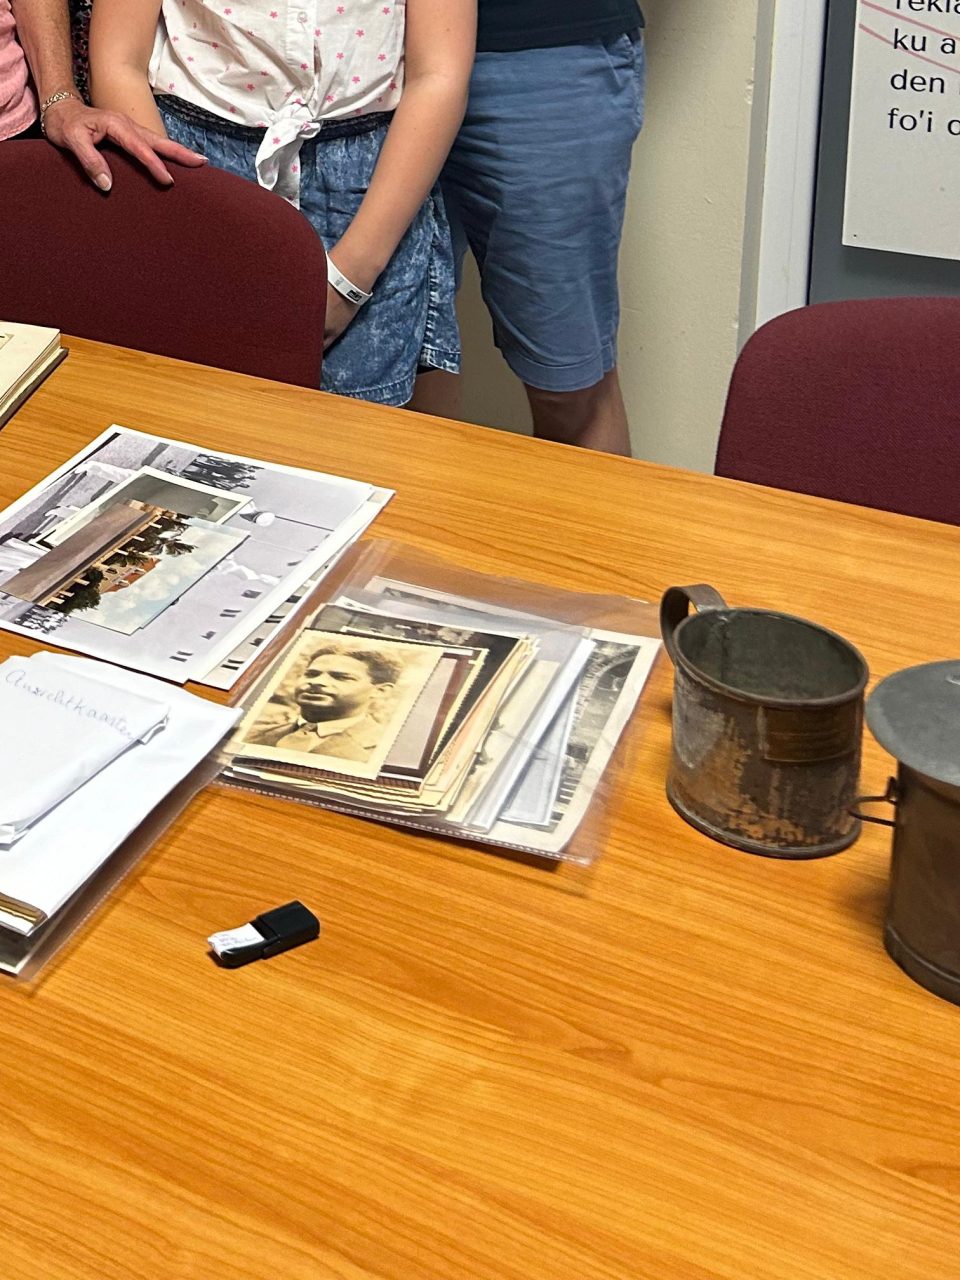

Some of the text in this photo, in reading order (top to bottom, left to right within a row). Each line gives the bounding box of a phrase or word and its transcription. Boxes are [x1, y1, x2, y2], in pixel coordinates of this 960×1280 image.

[893, 28, 956, 55] ku a
[890, 69, 945, 94] den
[887, 108, 933, 133] fo'i
